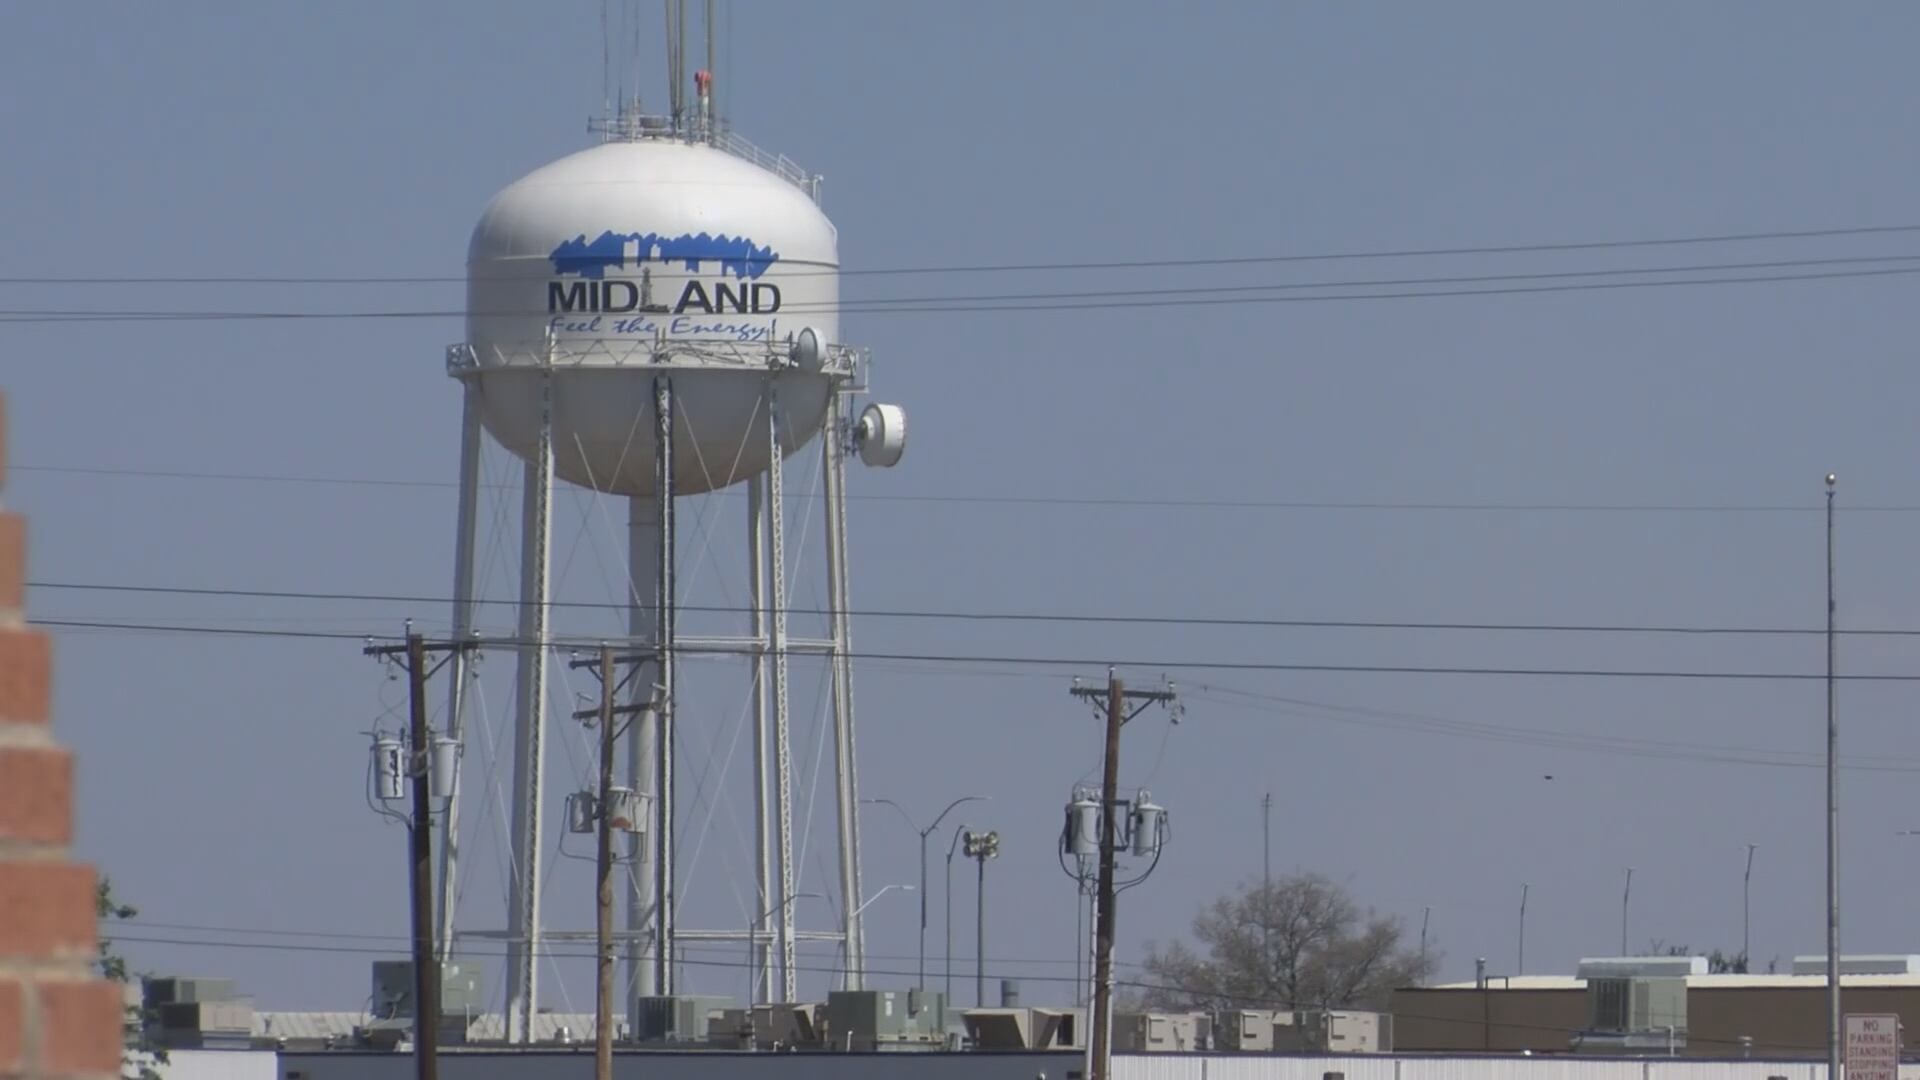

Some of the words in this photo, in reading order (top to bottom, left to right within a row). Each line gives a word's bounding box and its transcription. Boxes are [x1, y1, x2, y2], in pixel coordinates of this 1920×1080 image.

[548, 267, 781, 314] MIDLAND
[612, 316, 657, 334] the
[1863, 1020, 1879, 1032] NO
[1849, 1033, 1893, 1044] PARKING
[1848, 1046, 1894, 1057] STANDING
[1848, 1060, 1894, 1070] STOPPING
